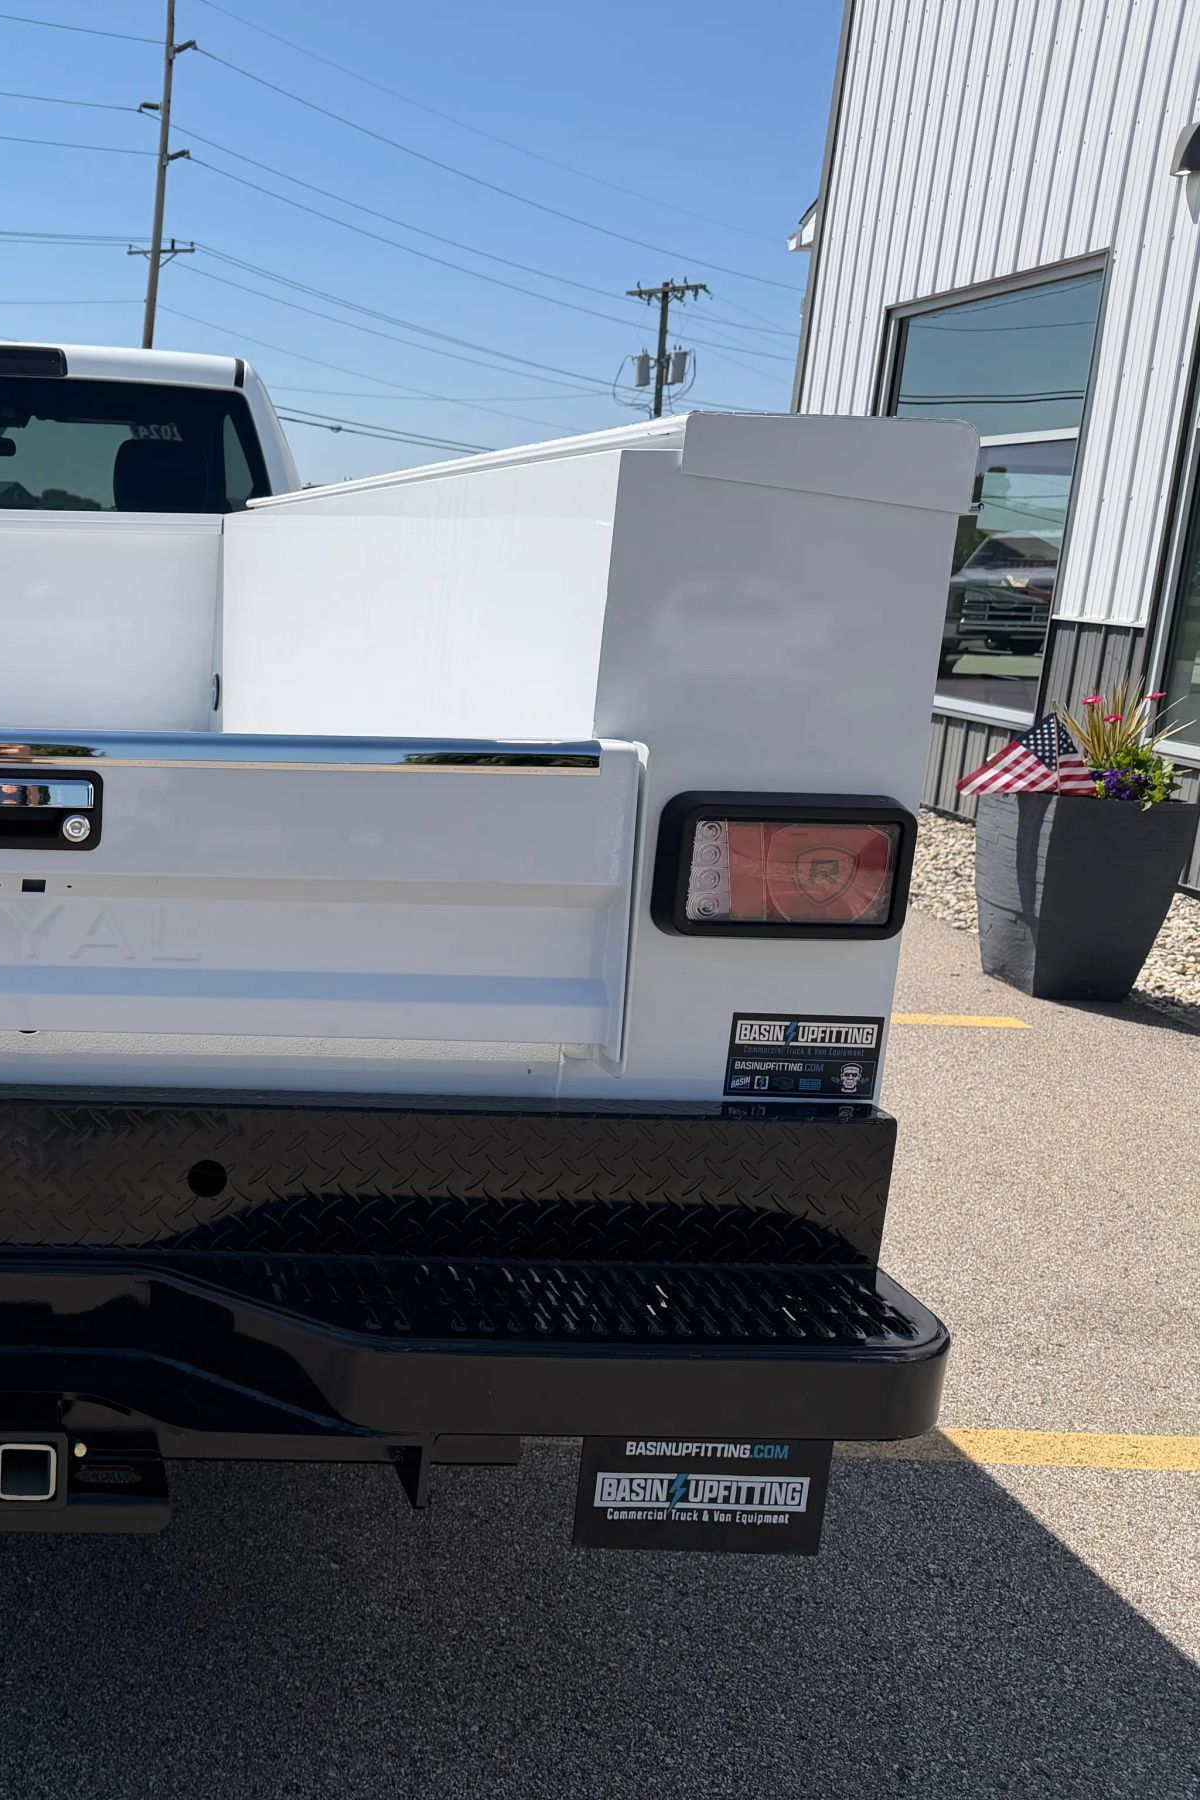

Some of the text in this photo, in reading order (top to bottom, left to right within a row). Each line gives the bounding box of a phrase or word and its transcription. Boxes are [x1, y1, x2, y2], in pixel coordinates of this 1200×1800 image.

[740, 1024, 873, 1045] BASIN UPFITTING
[734, 1060, 824, 1073] BASINUPFITTING.COM
[626, 1441, 789, 1460] BASINUPFITTING.COM
[601, 1478, 800, 1506] BASIN UPFITTING
[607, 1508, 789, 1525] Commercial Truck & Van Equipment
